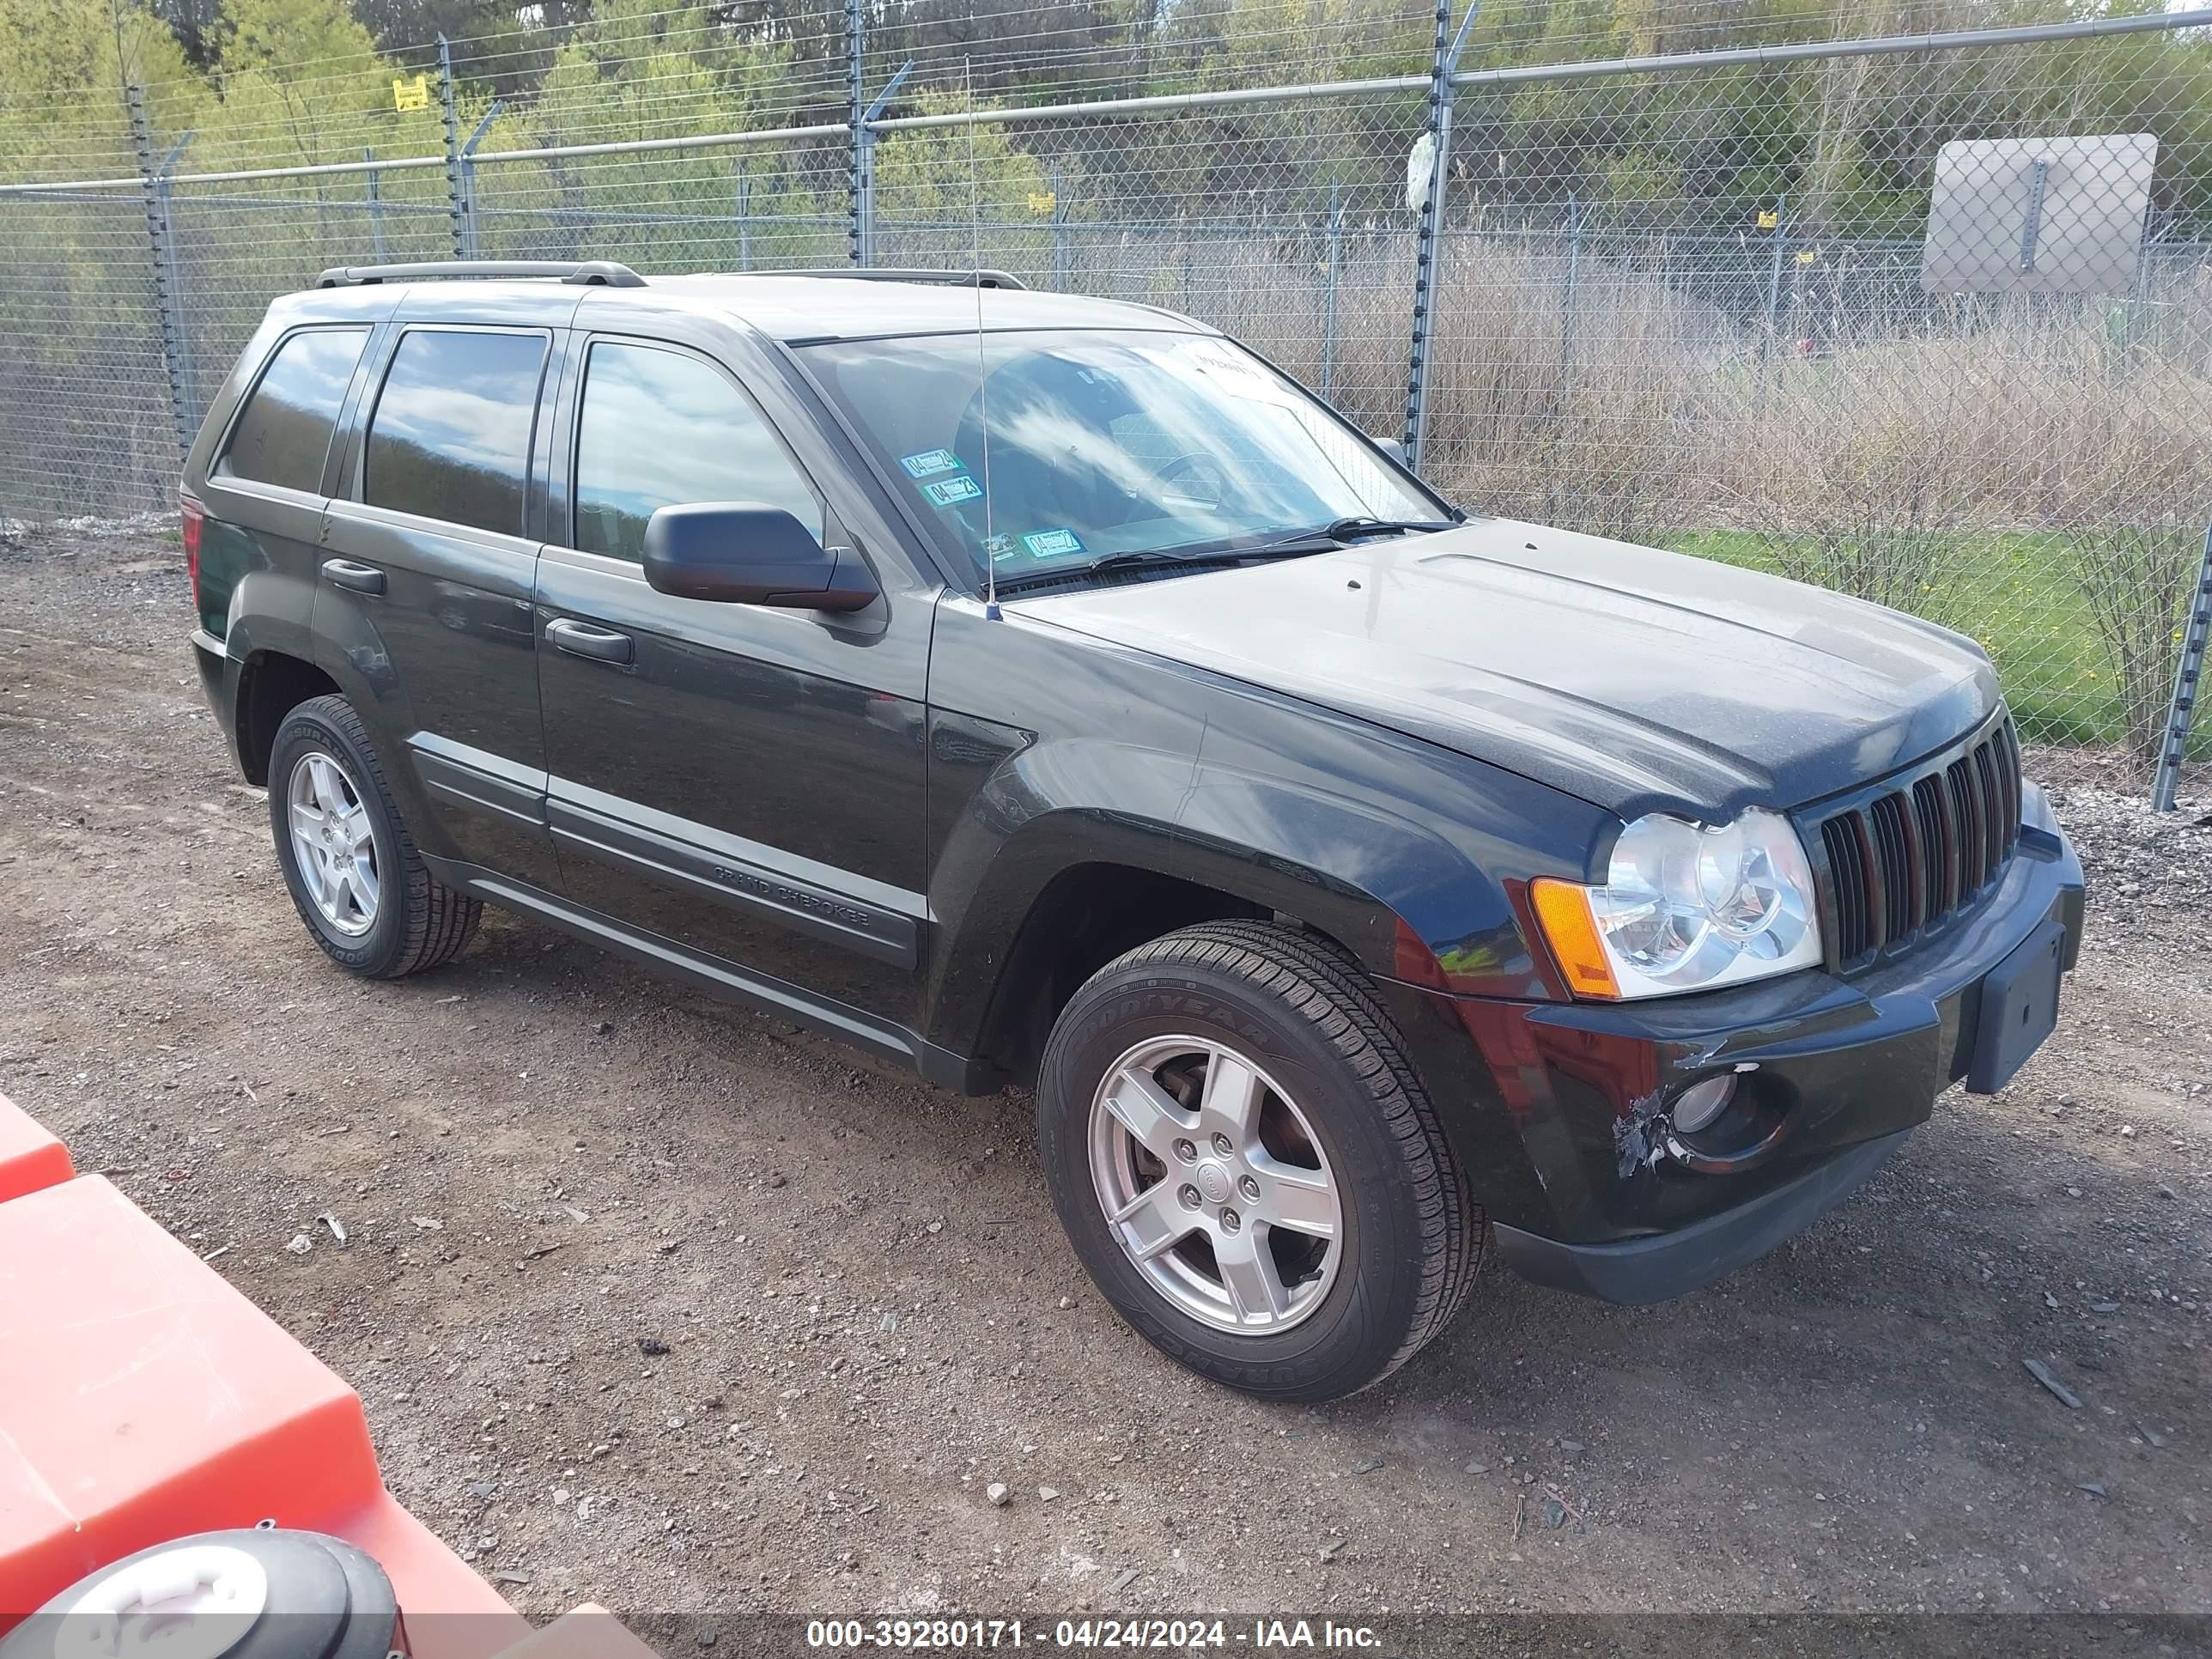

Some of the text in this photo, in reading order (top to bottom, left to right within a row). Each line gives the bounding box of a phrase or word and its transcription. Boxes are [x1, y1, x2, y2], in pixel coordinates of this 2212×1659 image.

[907, 451, 955, 474] 04 24
[931, 477, 979, 501] 04 23
[1030, 532, 1079, 554] 04 22
[714, 866, 871, 927] GRAND CHEROKEE
